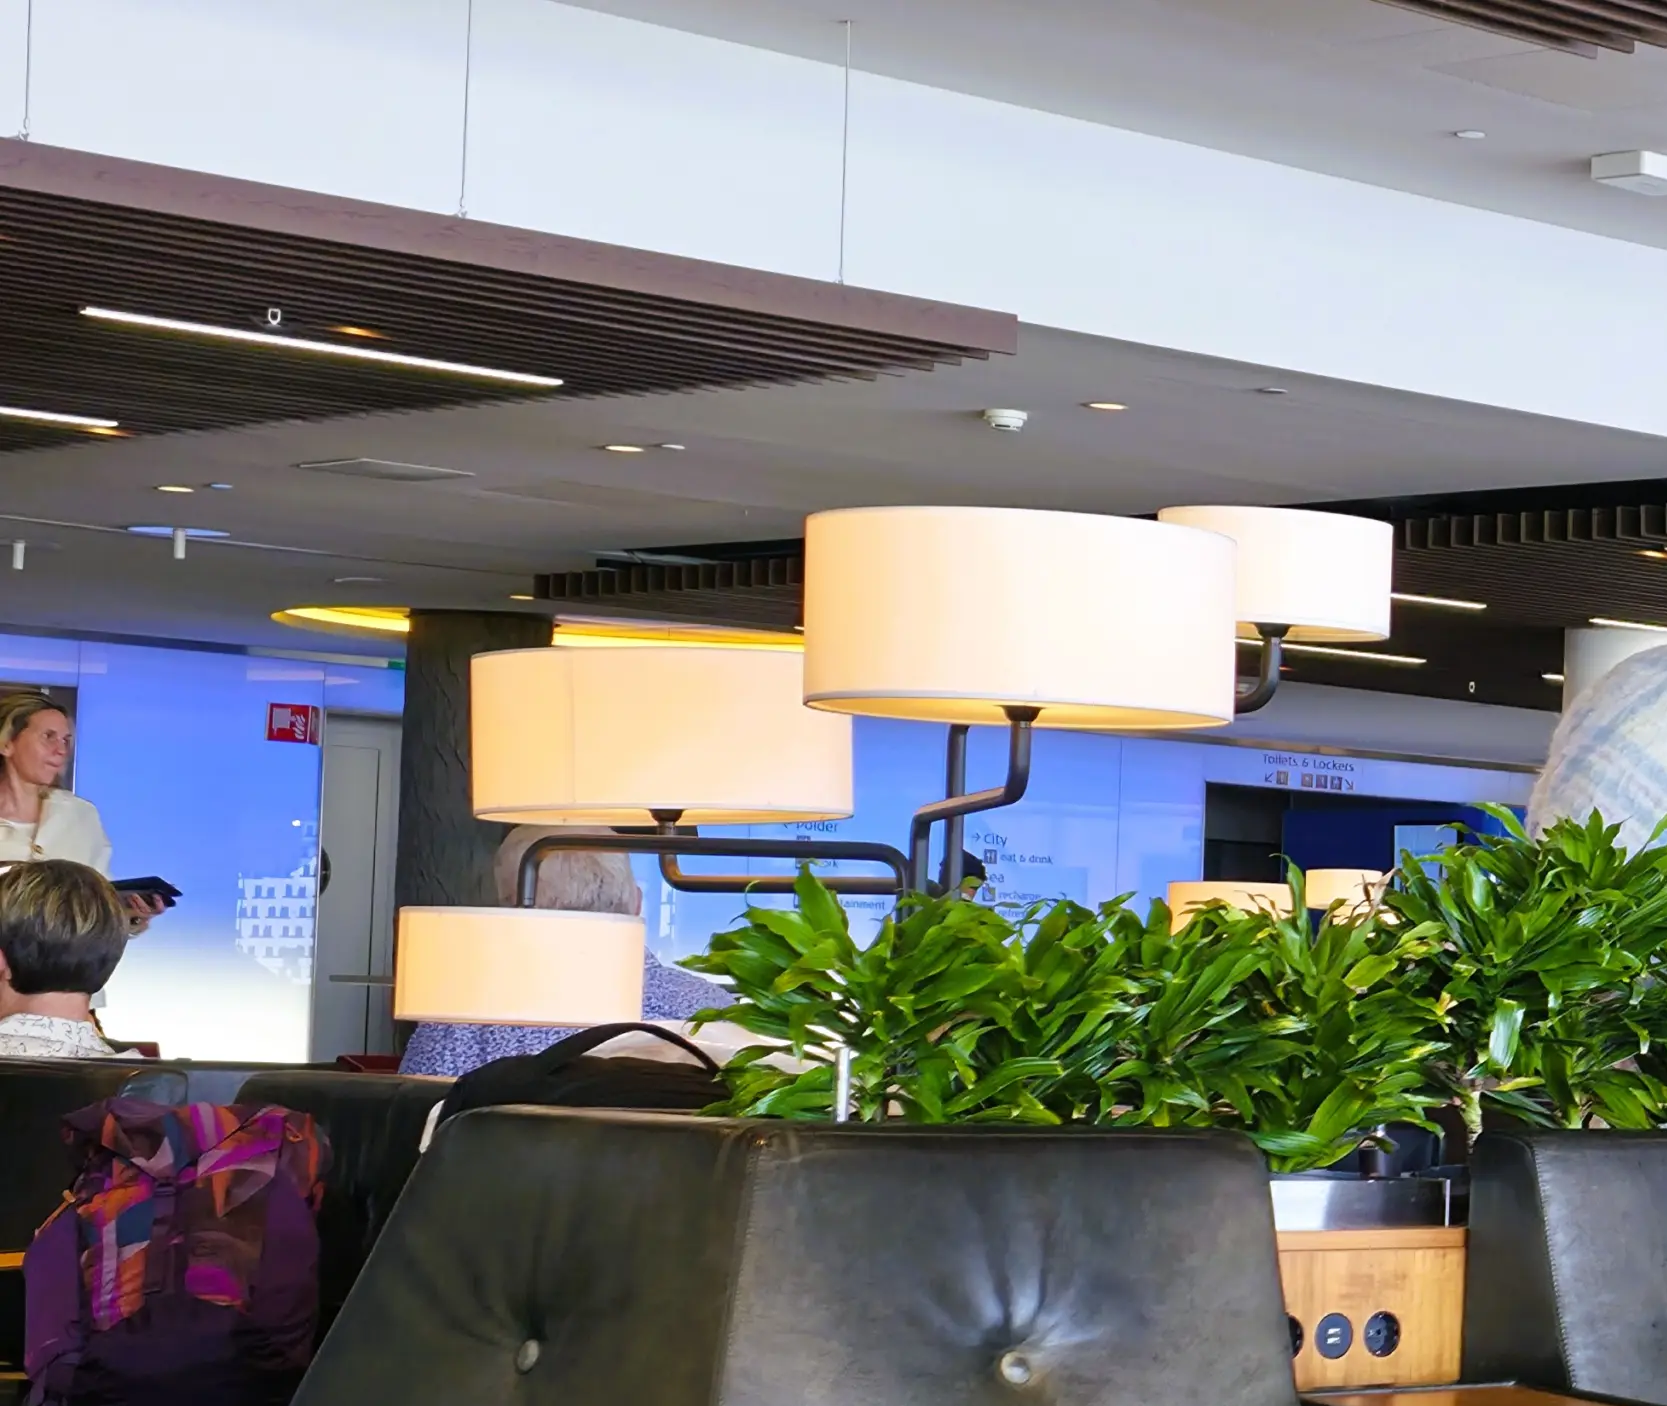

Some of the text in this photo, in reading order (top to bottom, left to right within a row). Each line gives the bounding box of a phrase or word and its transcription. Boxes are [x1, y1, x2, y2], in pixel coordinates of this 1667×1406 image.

[1263, 753, 1355, 772] Toilets & Lockers
[796, 820, 839, 833] Polder
[984, 832, 1007, 848] City
[1000, 852, 1017, 863] eat
[1028, 854, 1053, 865] drink
[987, 873, 1005, 883] ea
